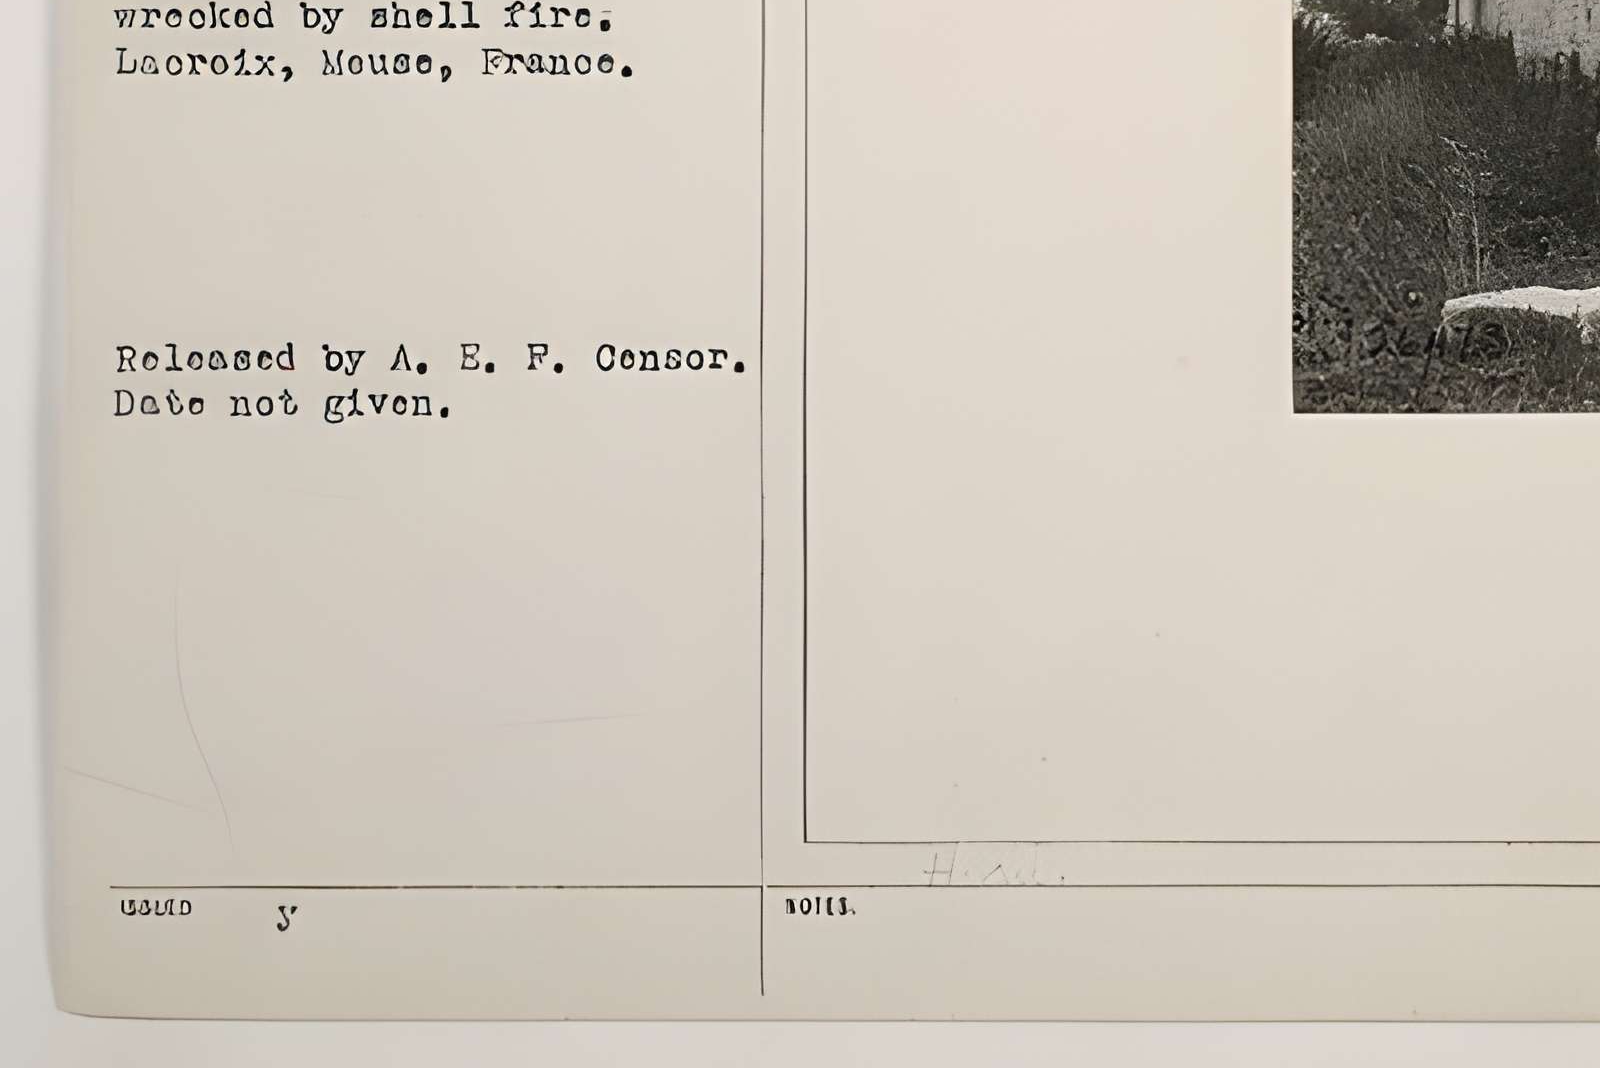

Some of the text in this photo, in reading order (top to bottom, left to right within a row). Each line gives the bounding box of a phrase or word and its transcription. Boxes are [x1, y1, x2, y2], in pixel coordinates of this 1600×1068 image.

[113, 0, 275, 30] wrecked
[299, 1, 345, 35] by
[370, 0, 481, 30] shell
[115, 46, 633, 83] Lacroix, Meuse, France.
[115, 341, 745, 377] Released by A. E. F. Censor.
[113, 387, 450, 425] Date not given.
